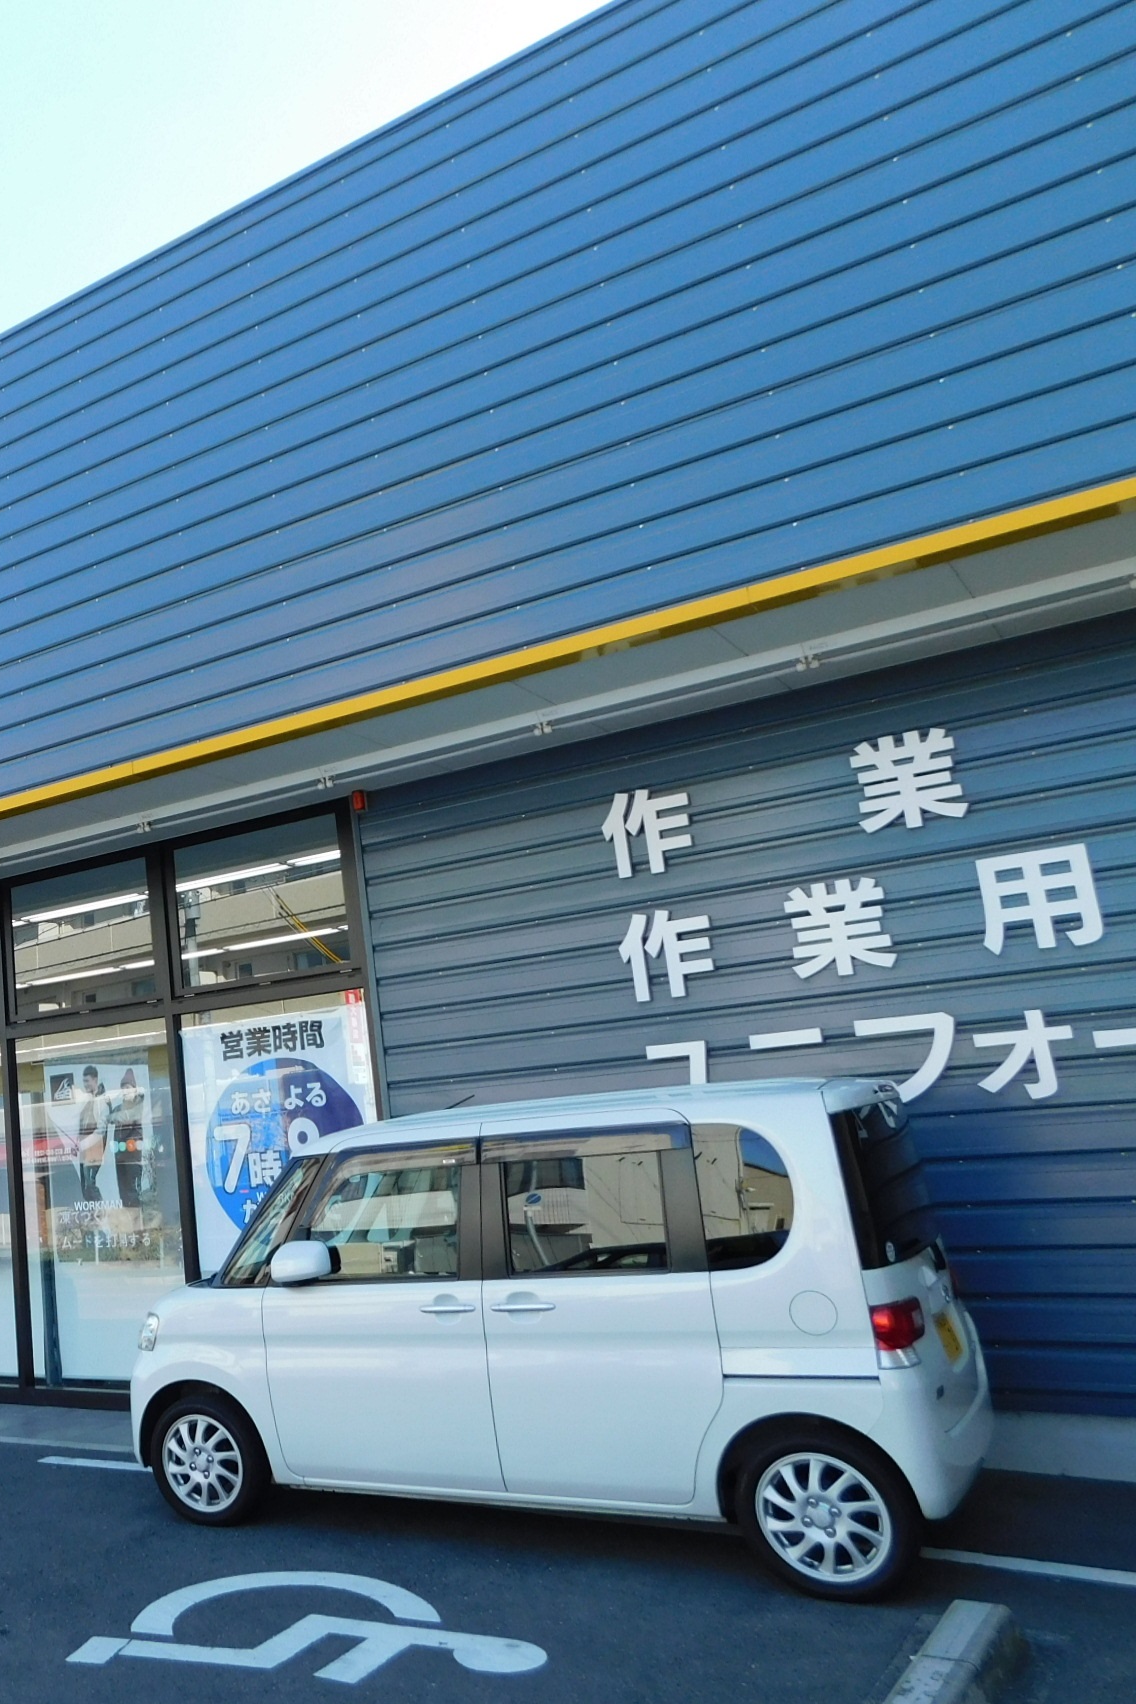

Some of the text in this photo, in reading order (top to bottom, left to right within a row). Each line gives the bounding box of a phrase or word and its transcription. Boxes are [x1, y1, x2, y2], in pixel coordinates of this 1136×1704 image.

[219, 1019, 325, 1061] 営業時間
[230, 1087, 272, 1116] あさ
[283, 1081, 328, 1110] よる
[213, 1123, 284, 1195] 7時
[74, 1199, 123, 1211] WORKMAN
